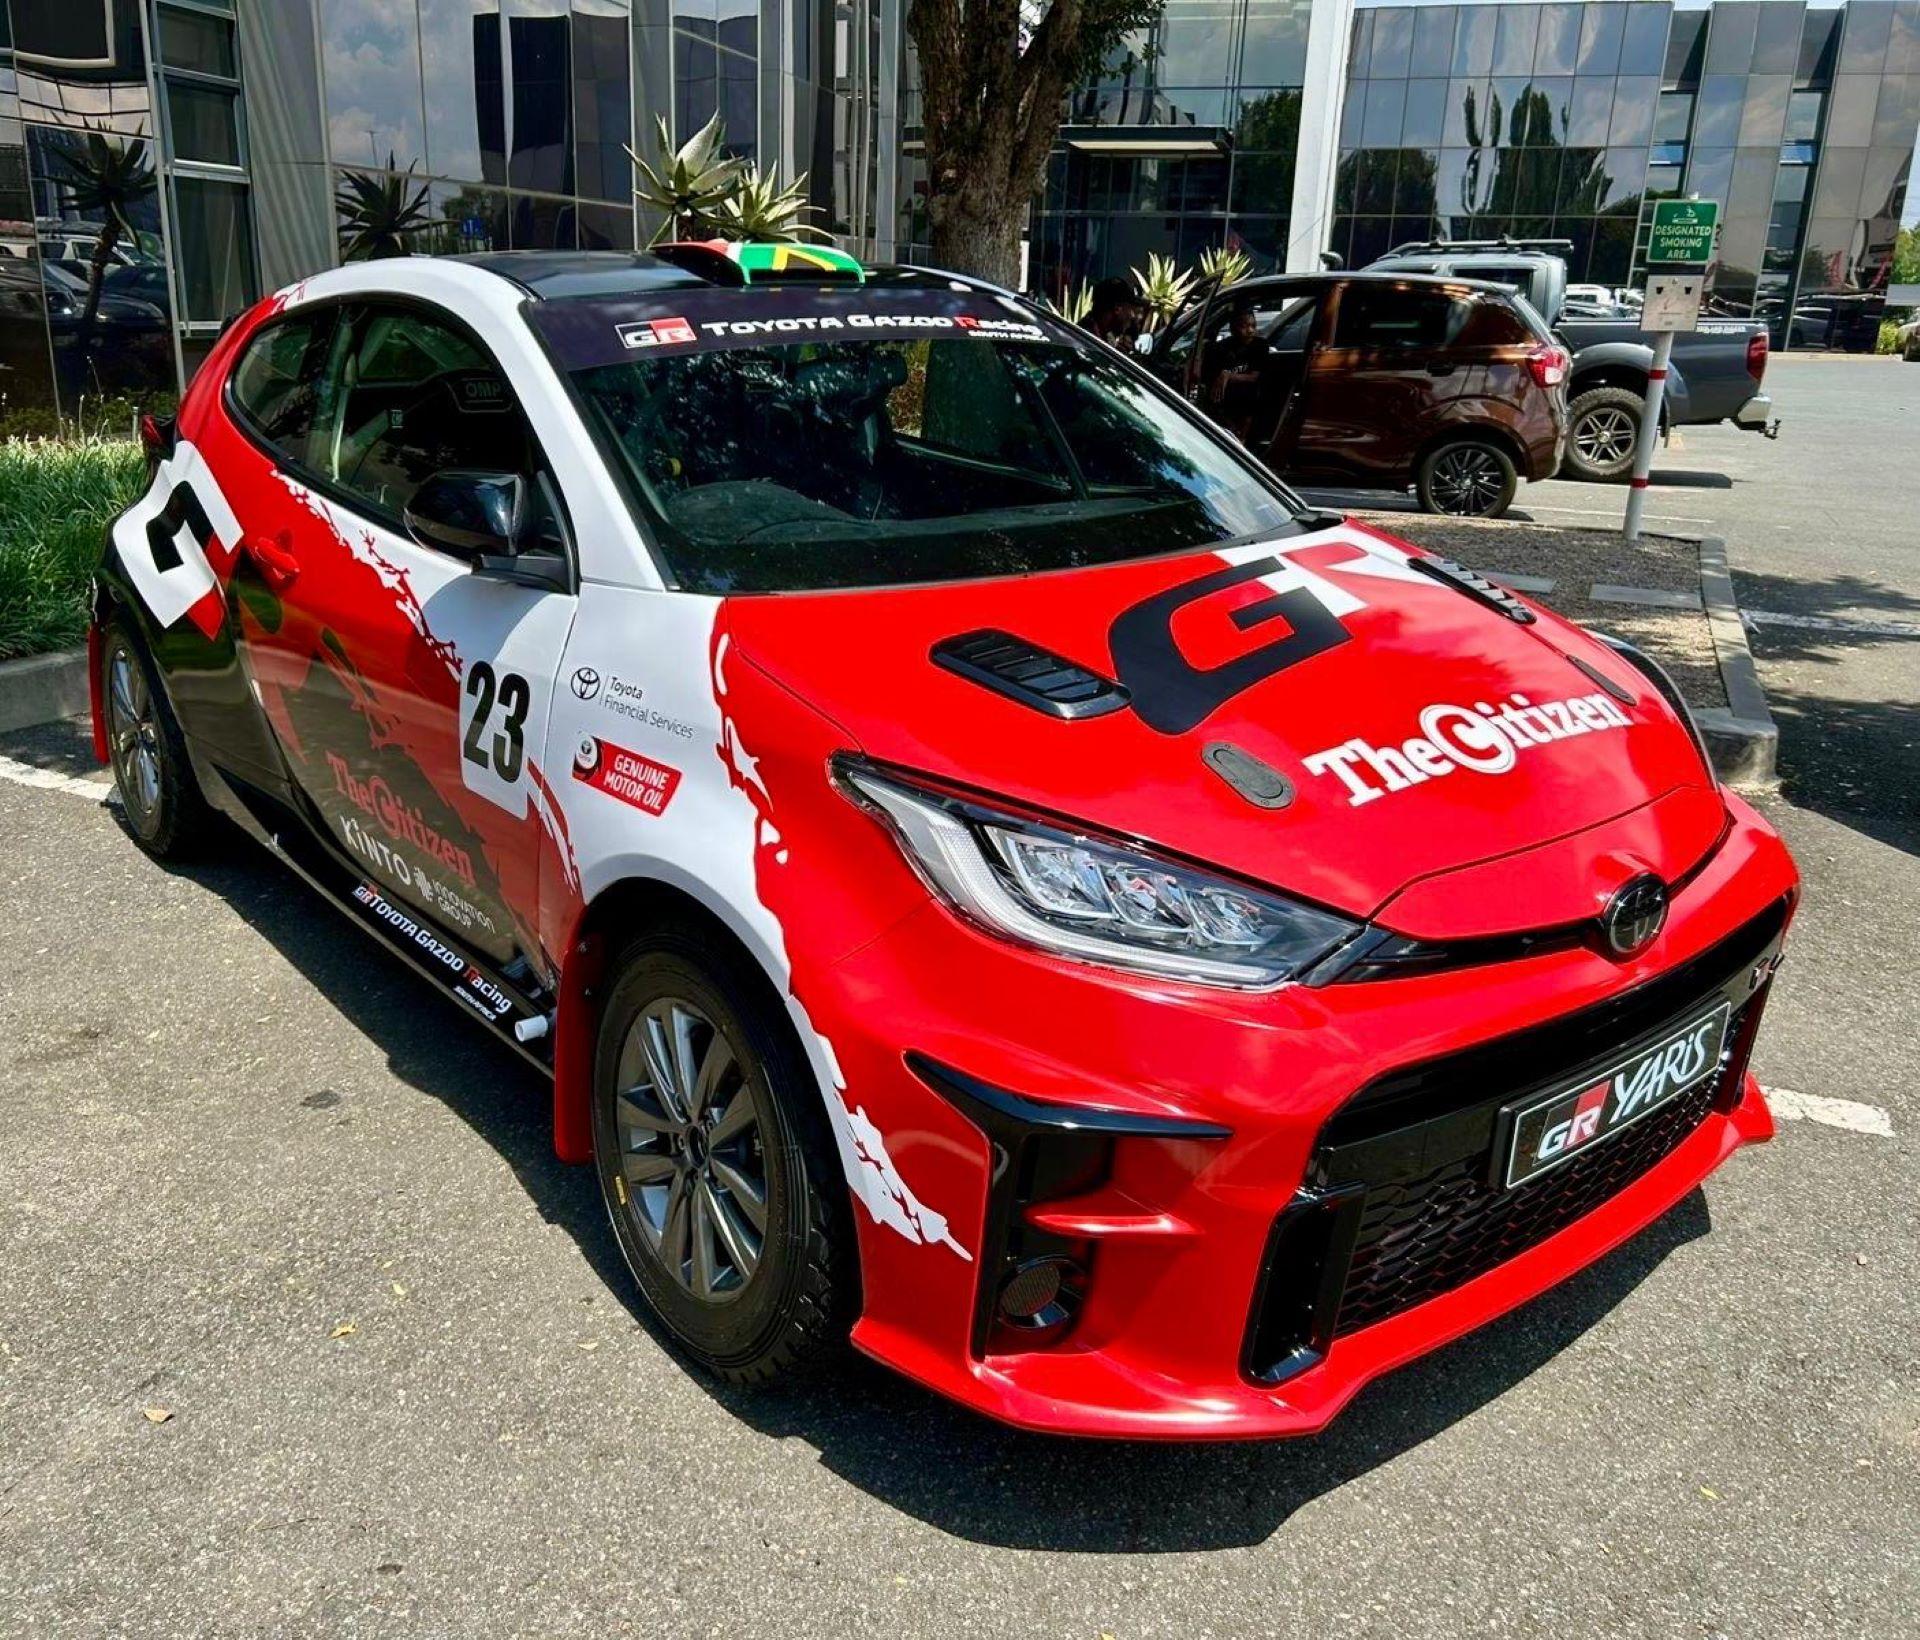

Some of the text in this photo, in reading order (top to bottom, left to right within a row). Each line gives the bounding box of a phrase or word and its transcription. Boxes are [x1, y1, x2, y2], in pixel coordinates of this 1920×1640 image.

[1655, 225, 1712, 236] DESIGNATED
[1660, 238, 1702, 248] SMOKING
[1666, 249, 1691, 259] AREA
[622, 314, 1044, 348] GR TOYOTA GAZOO Racing
[610, 676, 643, 699] Toyota
[463, 660, 531, 784] 23
[603, 695, 694, 739] Financial Services
[604, 769, 664, 808] MOTOR OIL
[614, 753, 669, 790] GENUINE
[368, 893, 419, 938] TOYOTA
[414, 929, 464, 971] GAZOO
[463, 964, 513, 1014] Racing
[1537, 1104, 1601, 1160] GR
